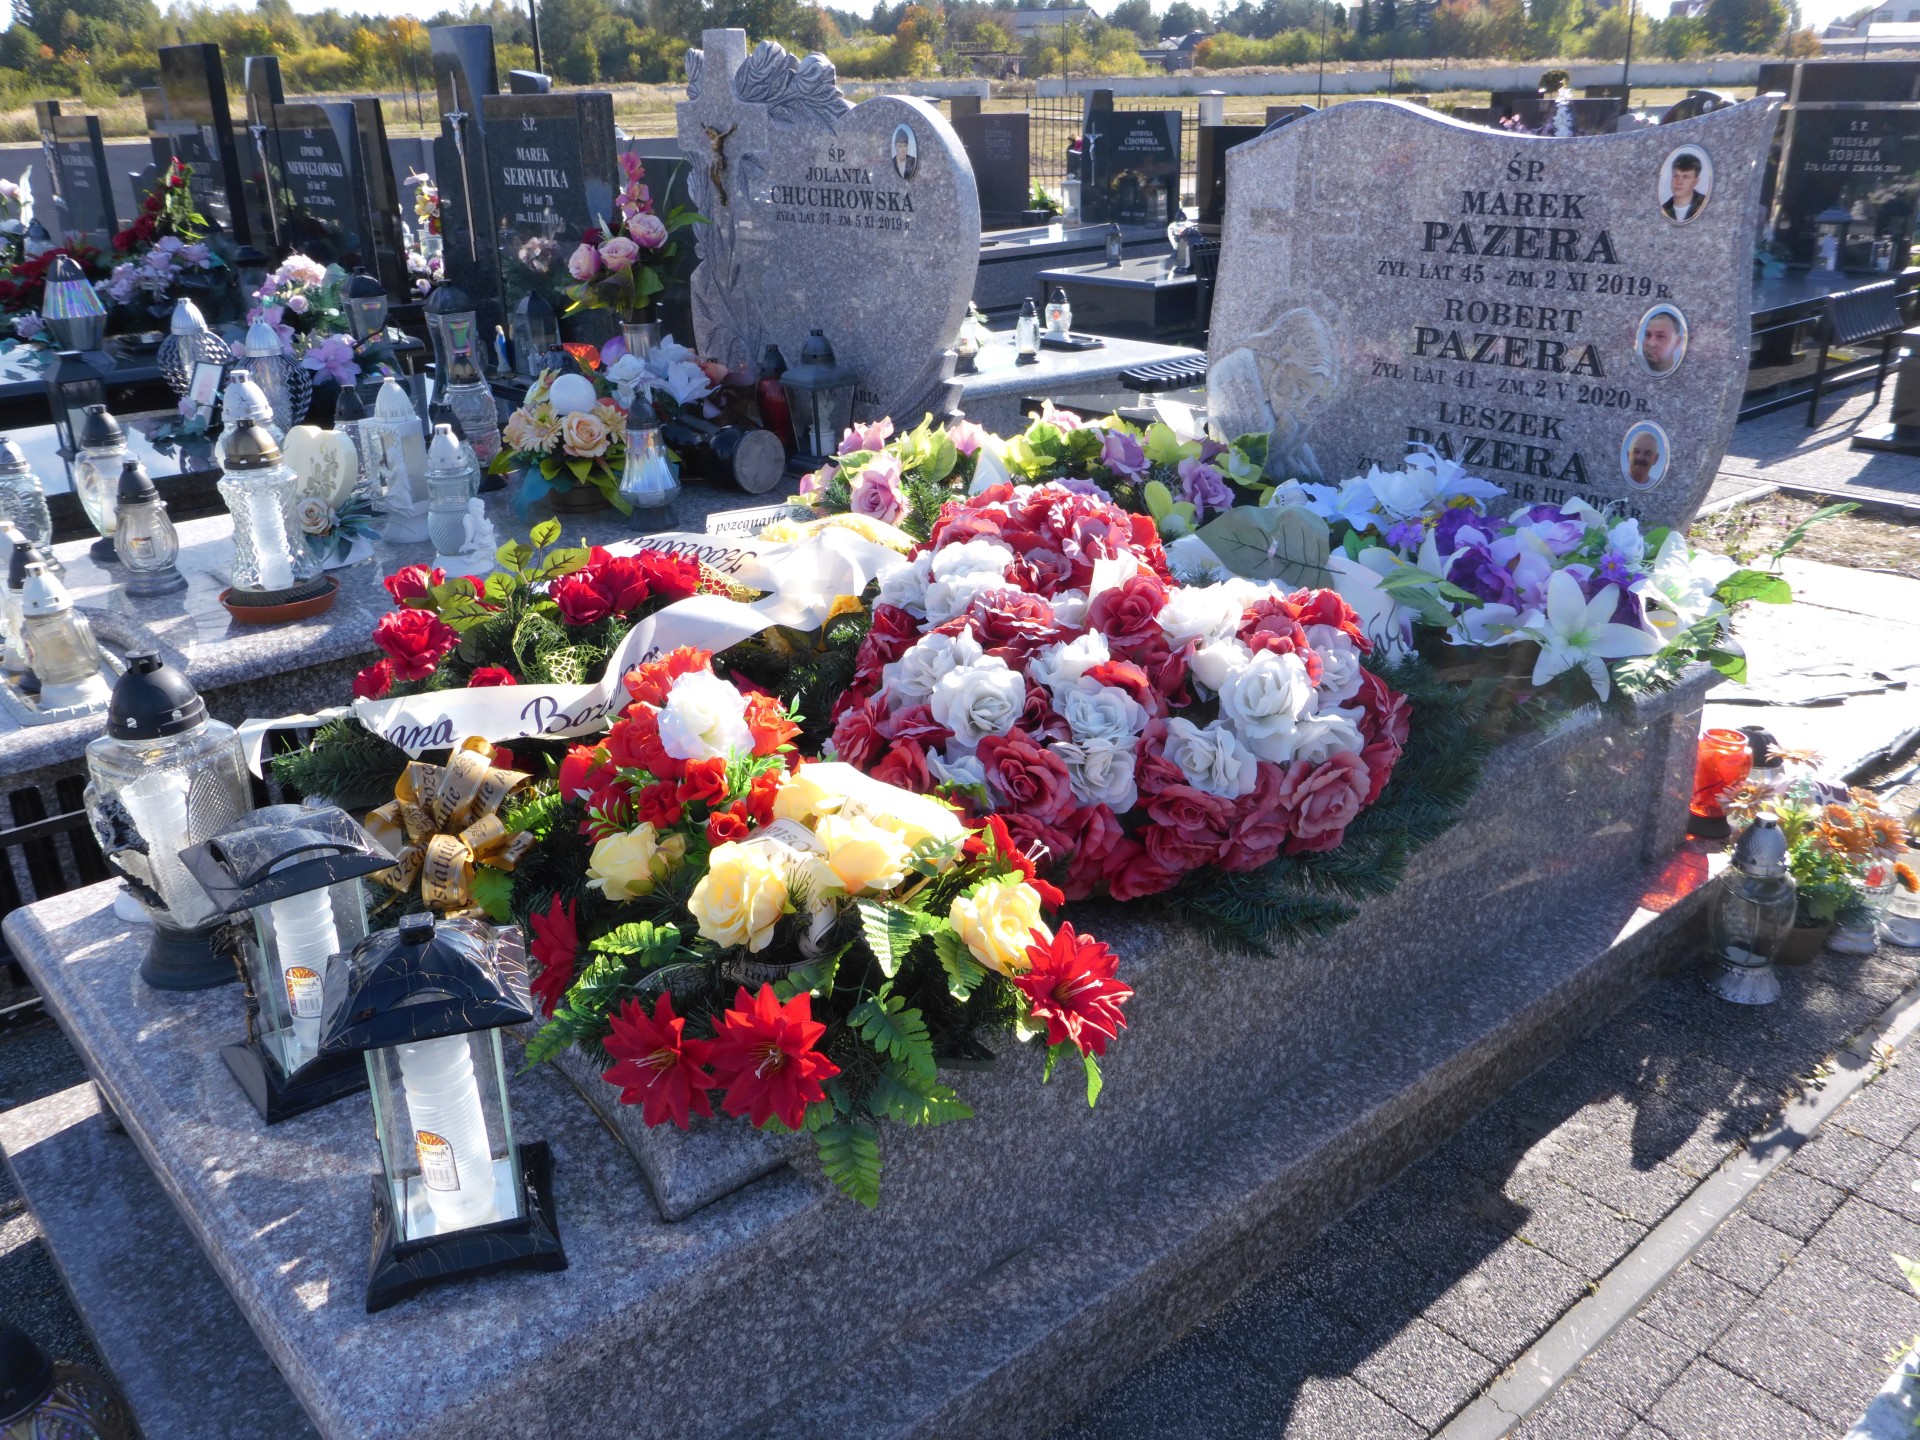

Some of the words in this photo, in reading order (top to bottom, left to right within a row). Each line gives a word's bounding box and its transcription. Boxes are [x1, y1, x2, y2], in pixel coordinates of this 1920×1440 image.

[516, 147, 550, 161] MAREK
[503, 167, 569, 188] SERWATKA
[805, 167, 871, 184] JOLANTA
[771, 185, 914, 212] CHUCHROWSKA
[1461, 190, 1586, 219] MAREK
[800, 213, 815, 224] LAT
[819, 212, 830, 225] 37
[856, 215, 861, 228] 5
[865, 216, 874, 229] XI
[879, 217, 902, 231] 2019
[1420, 221, 1621, 265] PAZERA
[1418, 264, 1453, 281] LAT
[1461, 264, 1485, 283] 45
[1544, 270, 1556, 289] 2
[1566, 272, 1587, 292] XI
[1597, 274, 1651, 297] 2019
[1444, 298, 1583, 334] ROBERT
[1412, 326, 1607, 378] PAZERA
[853, 391, 880, 405] ARIA
[1413, 367, 1446, 385] LAT
[1453, 369, 1476, 389] 41
[1535, 379, 1546, 400] 2
[1557, 382, 1571, 401] V
[1578, 385, 1631, 410] 2020
[1438, 401, 1565, 441] LESZEK
[1404, 426, 1592, 485] PAZERA
[1512, 480, 1534, 501] 16
